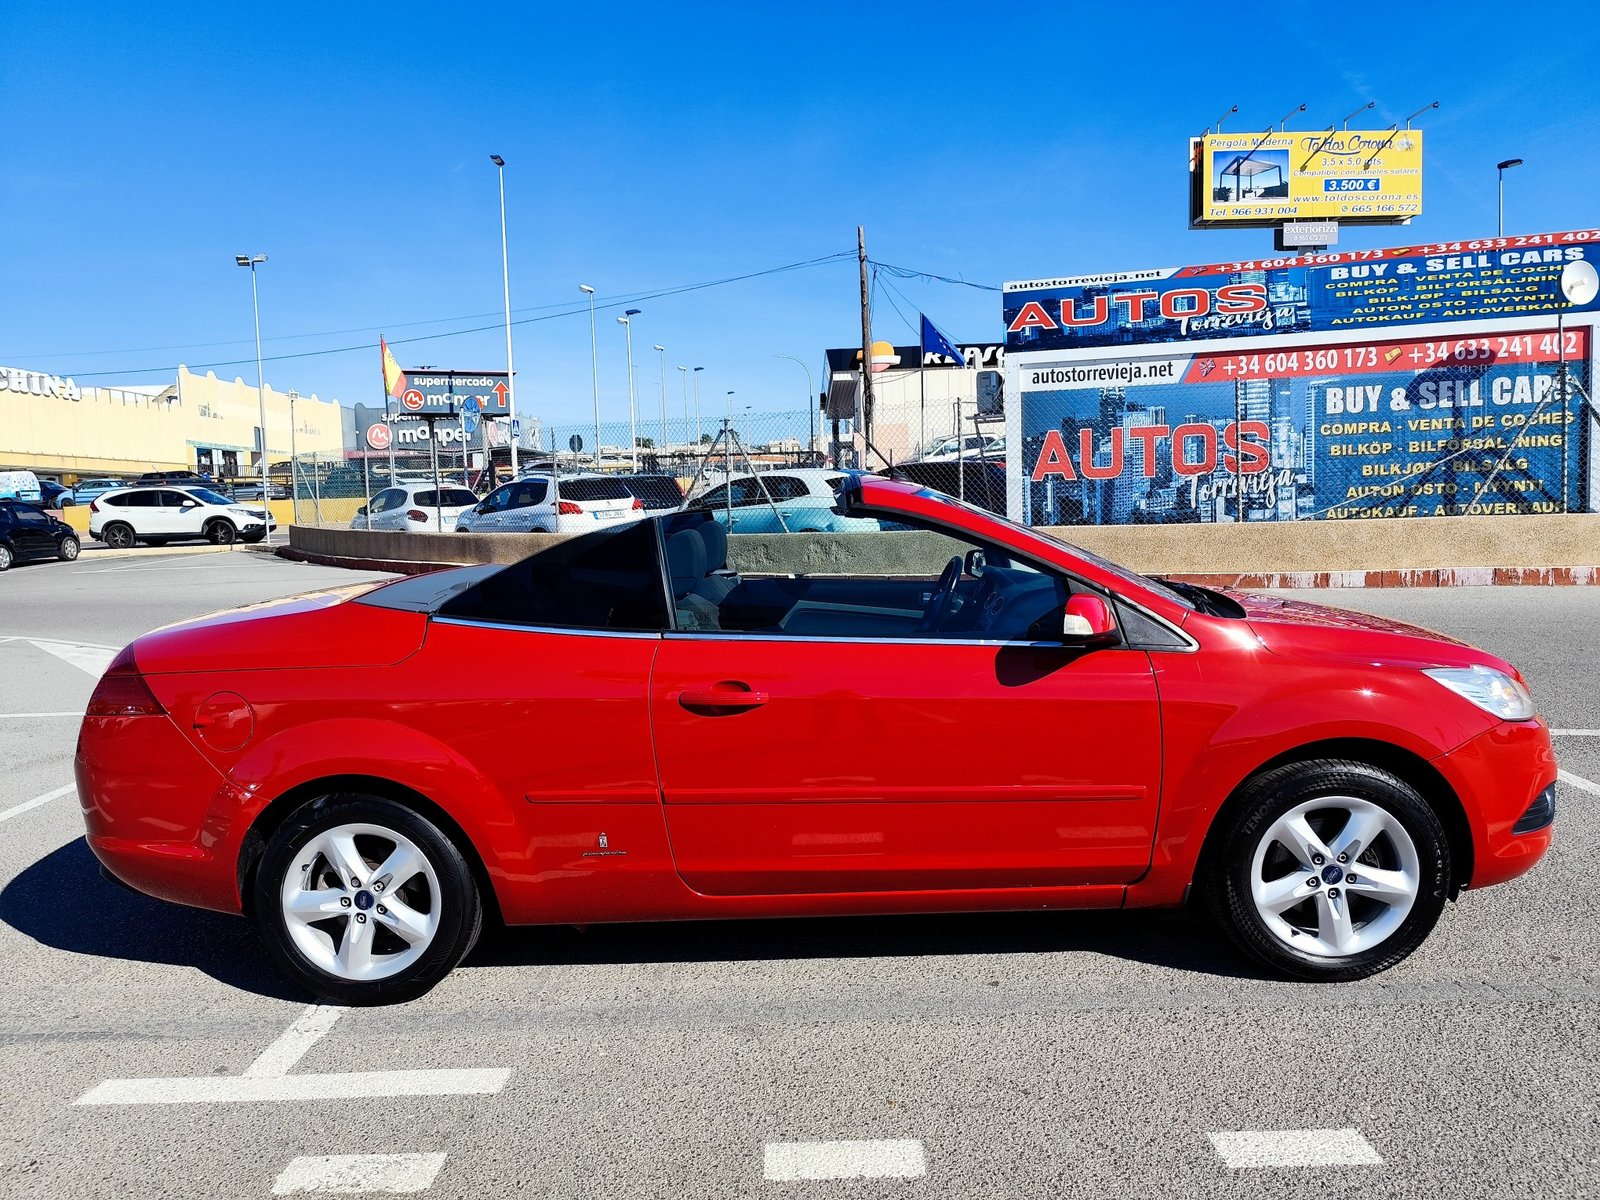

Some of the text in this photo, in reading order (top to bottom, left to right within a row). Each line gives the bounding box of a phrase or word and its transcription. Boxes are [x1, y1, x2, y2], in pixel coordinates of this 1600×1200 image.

[1210, 138, 1294, 148] Pergola Moderna
[1300, 135, 1392, 153] Toldos Corona
[1328, 180, 1377, 190] 3.500 €
[1210, 206, 1298, 216] Tel. 966 931 004
[1376, 204, 1395, 212] 166
[1216, 230, 1600, 273] +34 604 360 173 +34 633 241 402
[1330, 247, 1584, 280] BUY & SELL CARS
[1009, 270, 1162, 290] autostorrevieja.net
[1325, 278, 1398, 290] COMPRA
[1415, 272, 1474, 282] VENTA
[1480, 269, 1504, 277] DE
[1510, 265, 1565, 274] COCH
[1336, 286, 1399, 298] BILKÖP
[1416, 274, 1560, 291] BILFÖRSÄLJNIN
[1352, 304, 1412, 314] AUTON
[1418, 300, 1466, 309] OSTO
[1484, 294, 1555, 304] MYYNTI
[1368, 292, 1444, 304] BILKJØP
[1461, 286, 1538, 298] BILSALG
[1007, 284, 1268, 332] AUTOS
[1331, 312, 1425, 324] AUTOKAUF
[1442, 302, 1575, 316] AUTOVERKAUF
[1175, 307, 1294, 336] Torrevieja
[1222, 332, 1577, 376] +34 604 360 173 +34 633 241 402
[414, 376, 494, 388] supermercado
[1032, 361, 1174, 384] autostorrevieja.net
[1326, 384, 1382, 414] BUY
[1390, 387, 1410, 412] &
[1418, 379, 1483, 410] SELL
[1320, 421, 1392, 436] COMPRA
[1408, 418, 1466, 432] VENTA
[1472, 416, 1495, 428] DE
[1031, 420, 1270, 482] AUTOS
[1330, 442, 1392, 456] BILKÖP
[1362, 462, 1434, 476] BILKJØP
[1453, 458, 1528, 472] BILSALG
[1346, 484, 1405, 498] AUTON
[1411, 482, 1458, 496] OSTO
[1326, 506, 1418, 519] AUTOKAUF
